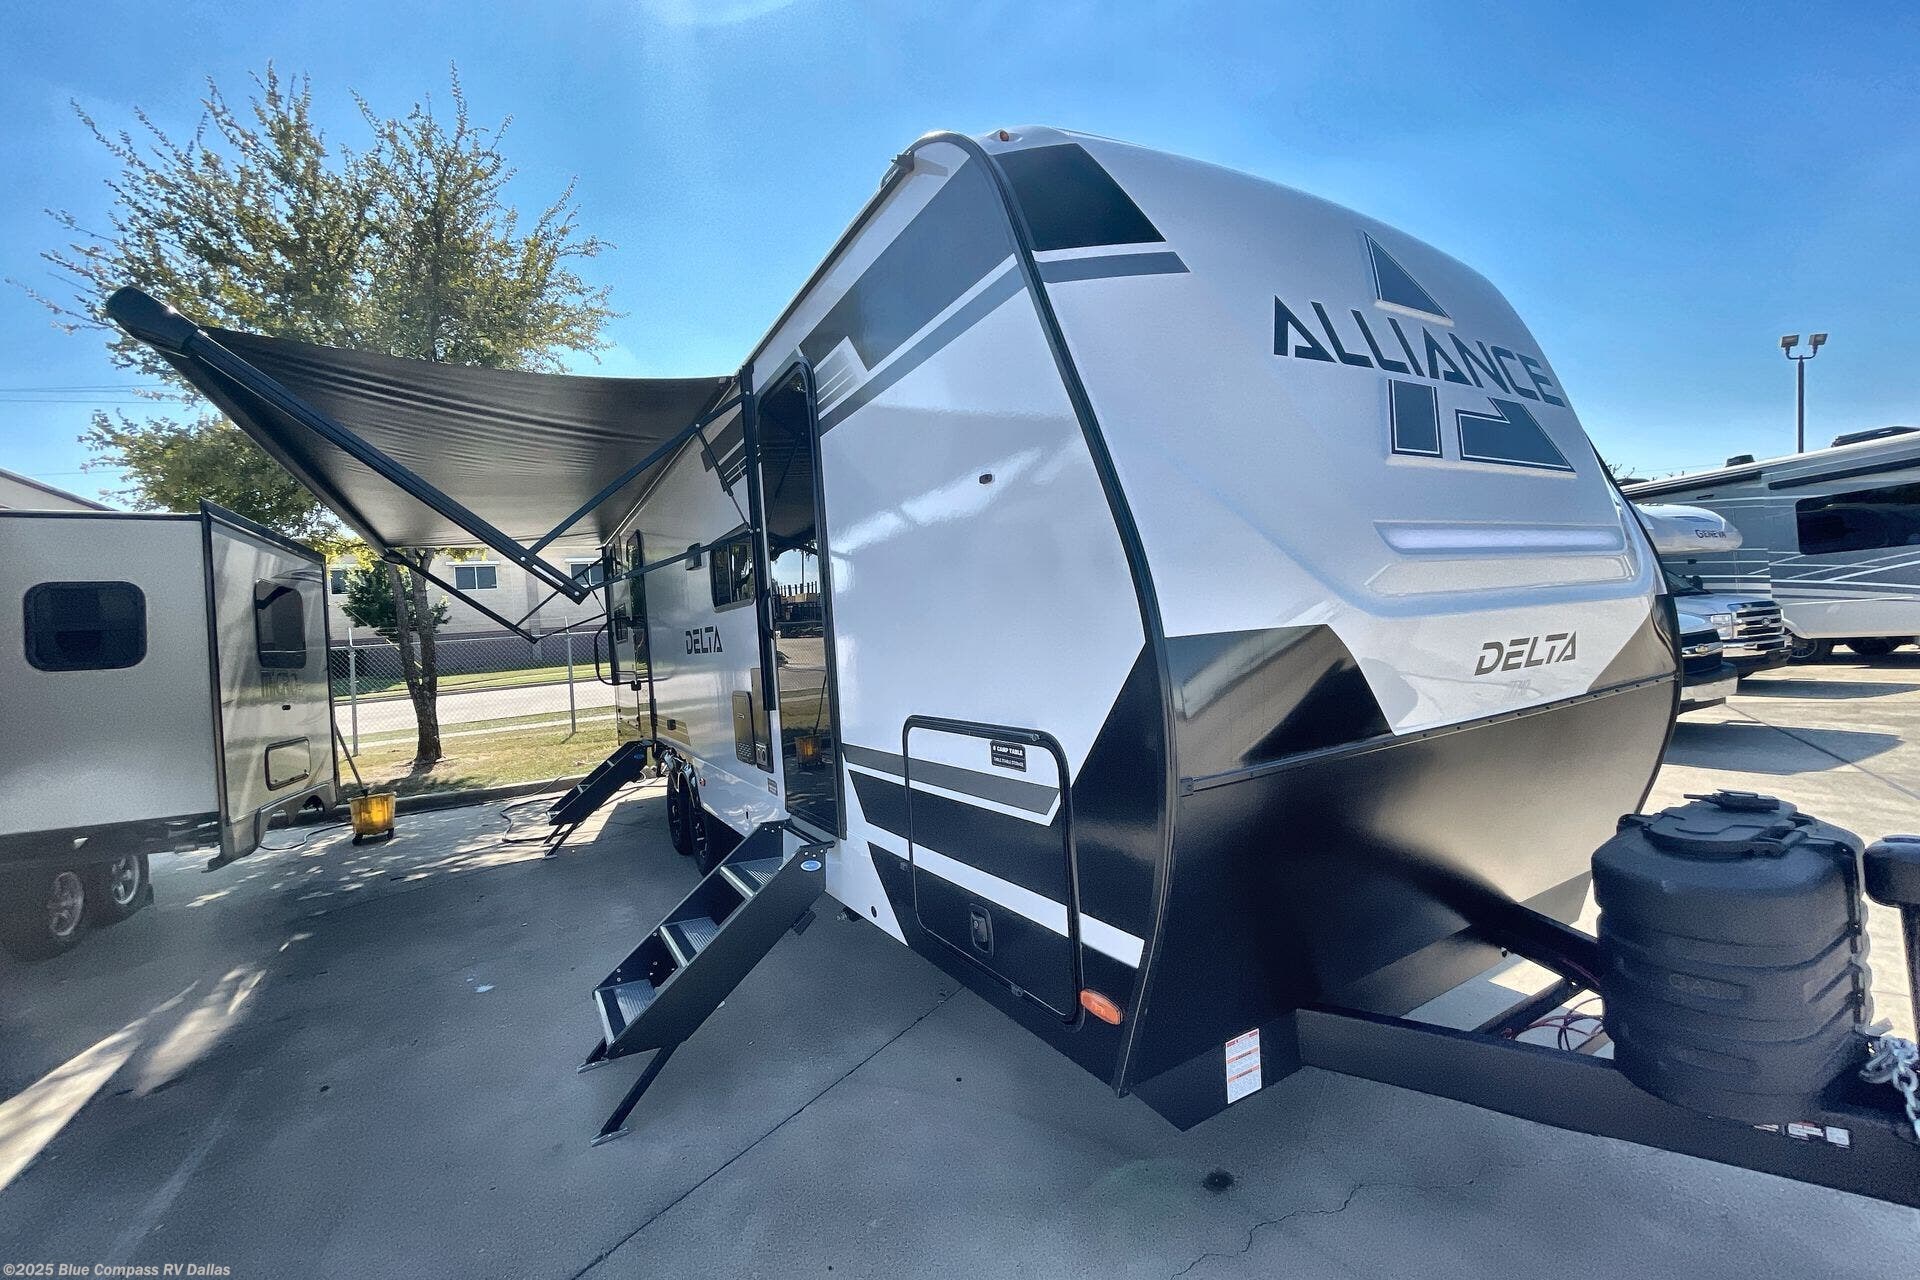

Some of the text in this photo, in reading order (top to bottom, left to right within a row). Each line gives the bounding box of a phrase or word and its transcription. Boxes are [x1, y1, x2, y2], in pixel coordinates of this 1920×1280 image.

[1273, 294, 1567, 407] ALLIANCE
[1694, 529, 1727, 539] GENEVA
[685, 625, 723, 655] DELTA
[1474, 630, 1577, 676] DELTA
